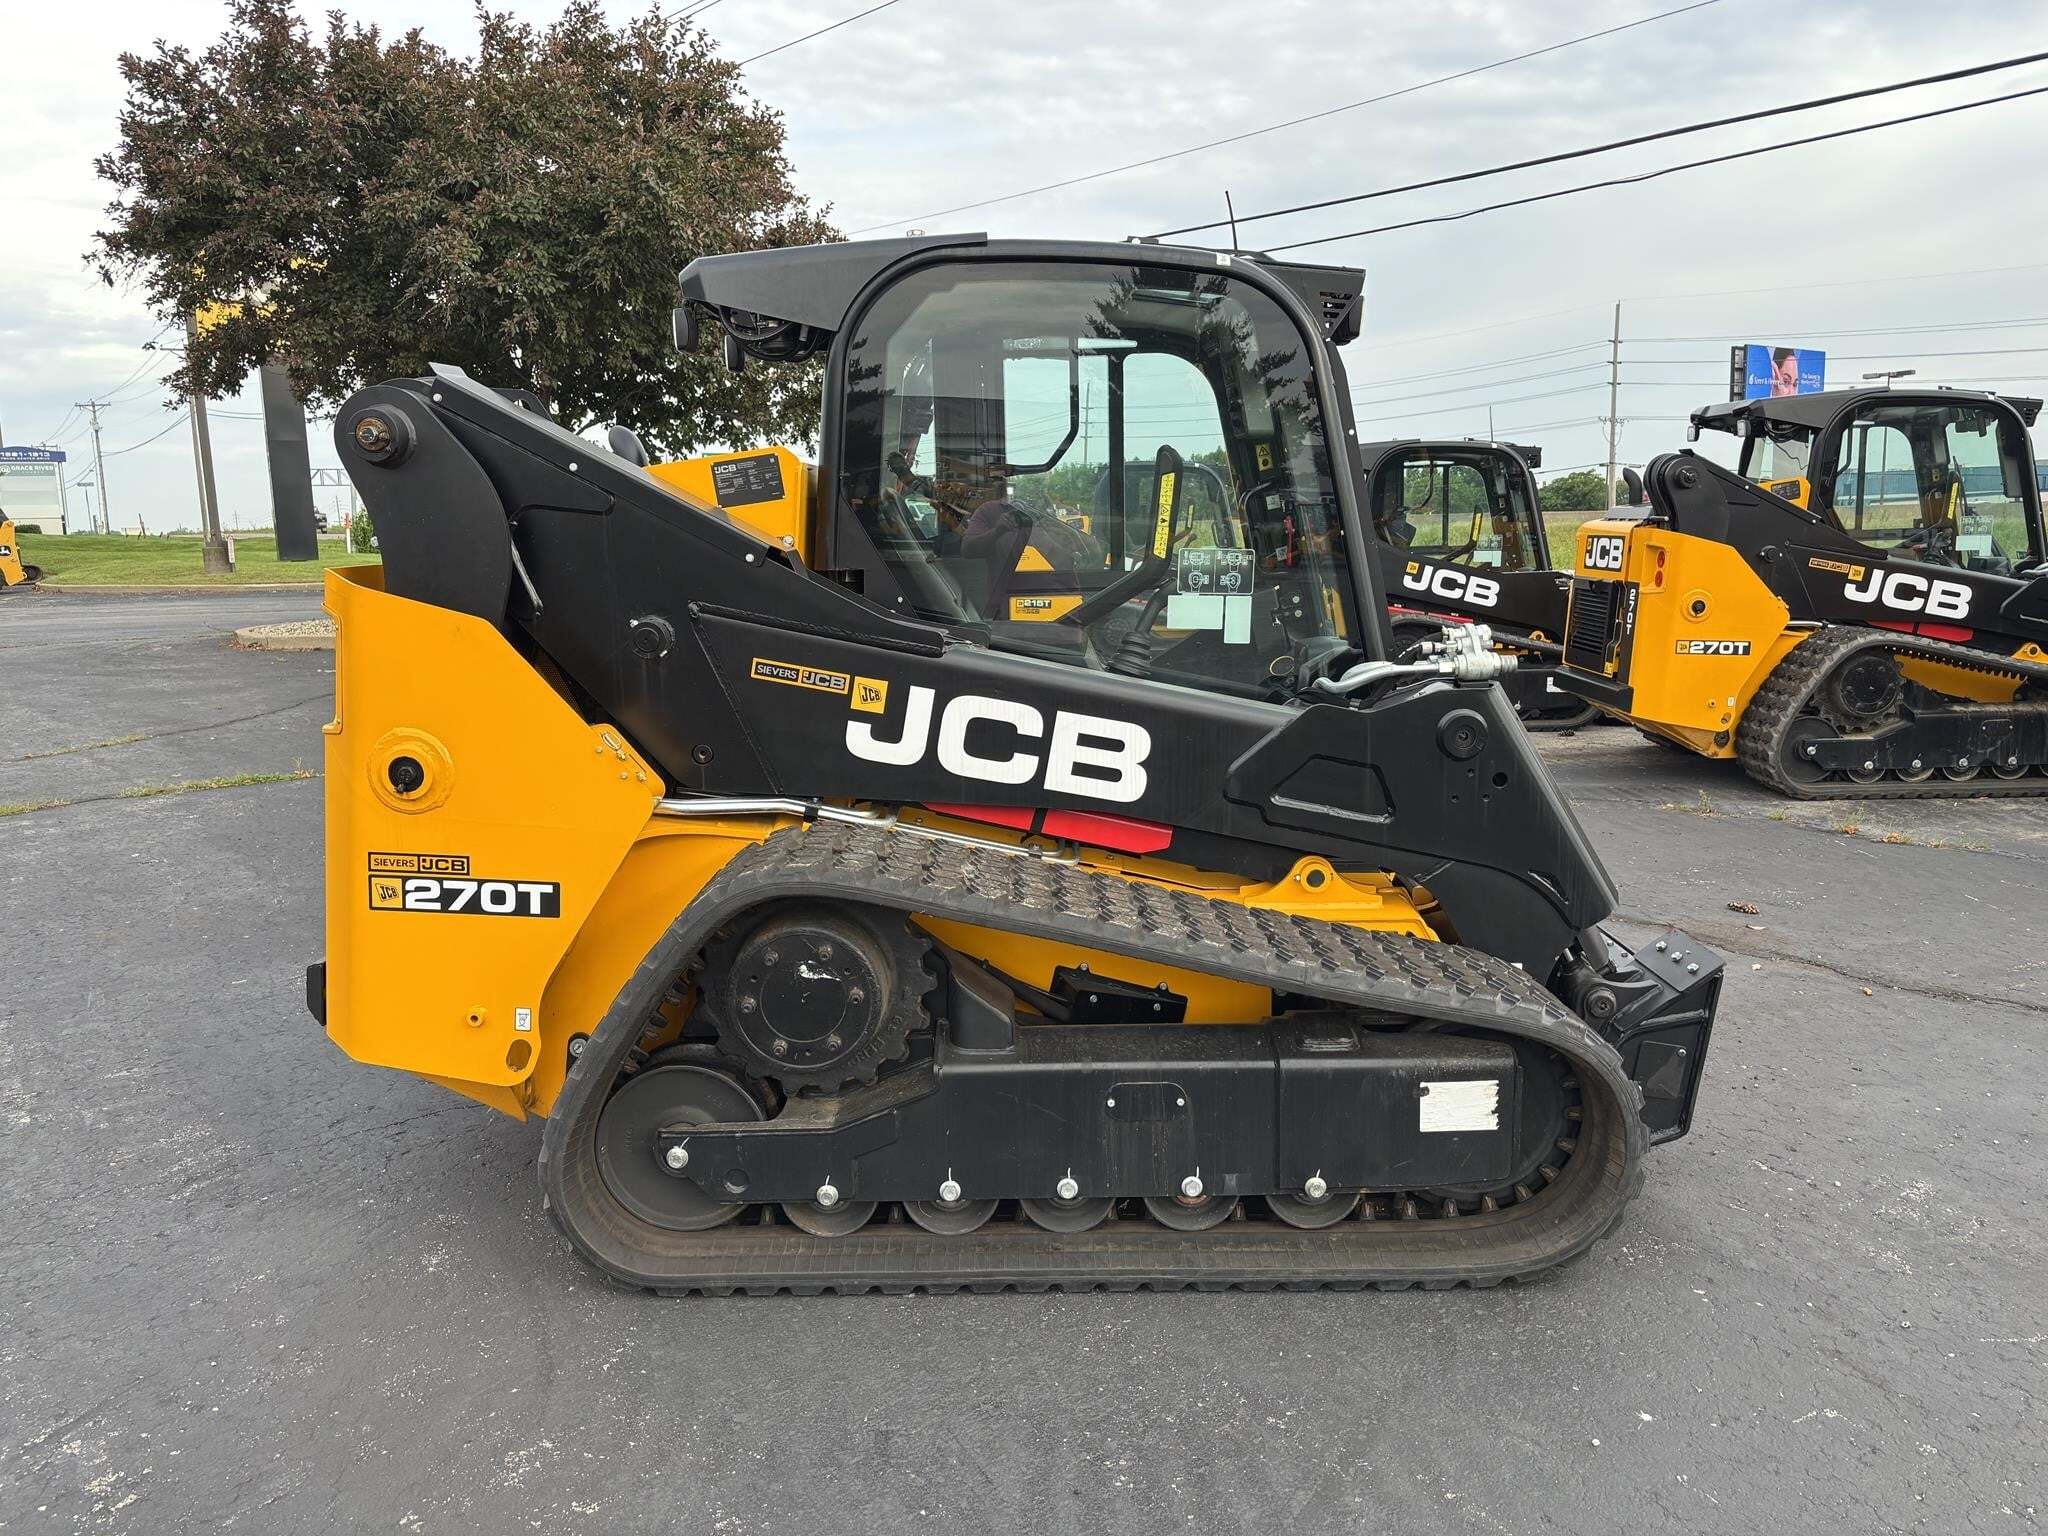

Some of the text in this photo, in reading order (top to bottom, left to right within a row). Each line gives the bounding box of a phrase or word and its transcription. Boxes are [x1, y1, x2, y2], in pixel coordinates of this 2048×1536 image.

[714, 464, 737, 474] JCB
[1585, 538, 1623, 569] JCB
[1403, 564, 1500, 607] JCB
[1844, 568, 1973, 620] JCB
[1626, 588, 1636, 635] 270T
[1689, 641, 1749, 655] 270T
[757, 664, 845, 690] SIEVERS JCB
[861, 686, 880, 702] JCB
[845, 685, 1152, 803] JCB
[373, 857, 466, 872] SIEVERS JCB
[379, 885, 399, 900] JCB
[405, 879, 553, 915] 270T
